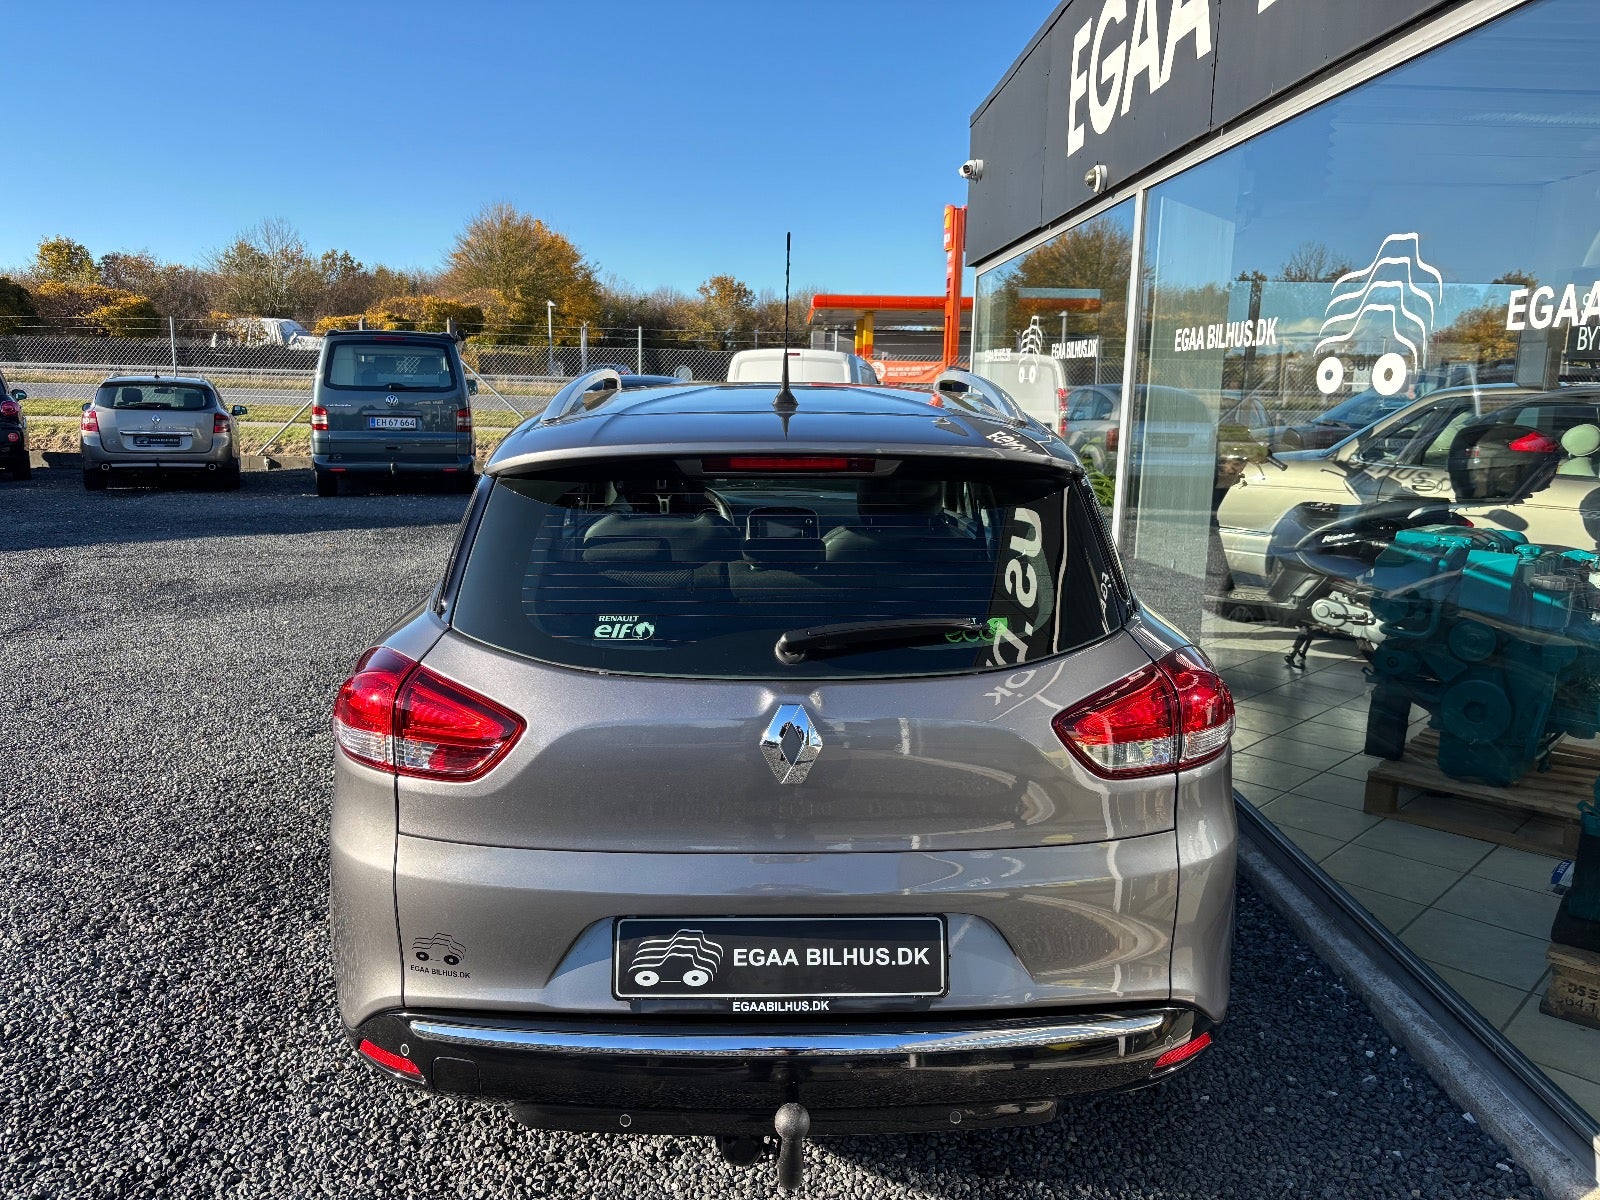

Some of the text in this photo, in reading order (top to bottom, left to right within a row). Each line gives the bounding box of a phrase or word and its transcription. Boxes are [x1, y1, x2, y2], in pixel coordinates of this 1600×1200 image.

[1174, 316, 1279, 352] EGAA BILHUS.DK
[376, 419, 415, 427] EH 67 664
[594, 623, 634, 639] elf
[733, 947, 930, 967] EGAA BILHUS.DK
[410, 964, 471, 979] EGAA BILHUS.DK
[732, 1000, 830, 1012] EGAABILHUS.DK
